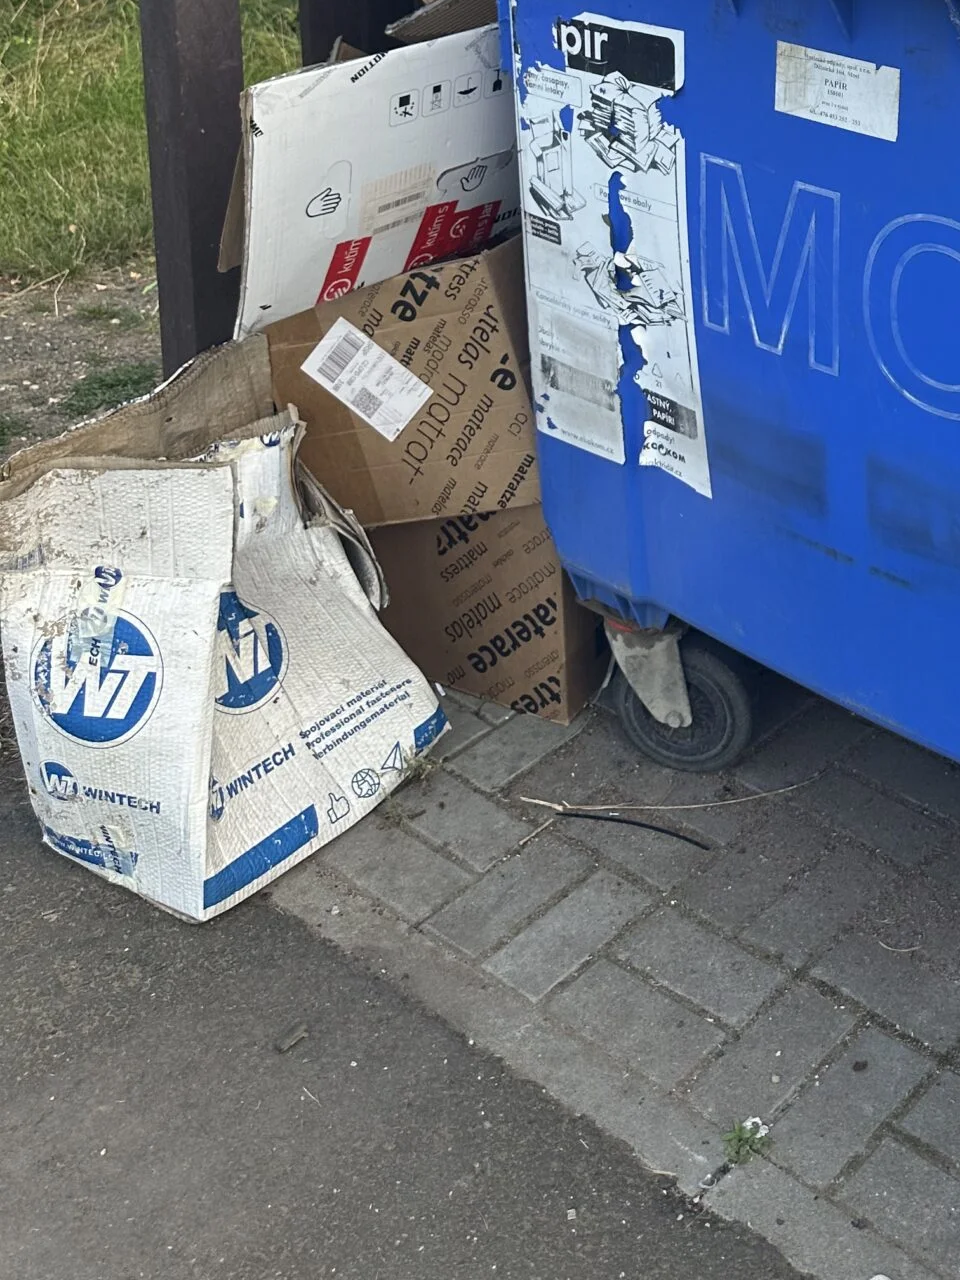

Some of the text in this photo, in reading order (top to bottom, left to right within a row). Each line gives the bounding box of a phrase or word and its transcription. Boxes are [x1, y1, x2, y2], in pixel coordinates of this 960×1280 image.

[557, 20, 609, 61] pír
[646, 393, 672, 413] ASTNÝ,
[446, 393, 494, 468] materace
[431, 477, 458, 516] matelas
[497, 453, 536, 509] matratze
[440, 540, 488, 584] mattress
[505, 562, 557, 605] matrace
[444, 591, 501, 644] matelas
[305, 677, 413, 750] Professional fasteners
[226, 742, 297, 799] WINTECH
[83, 785, 161, 814] WINTECH
